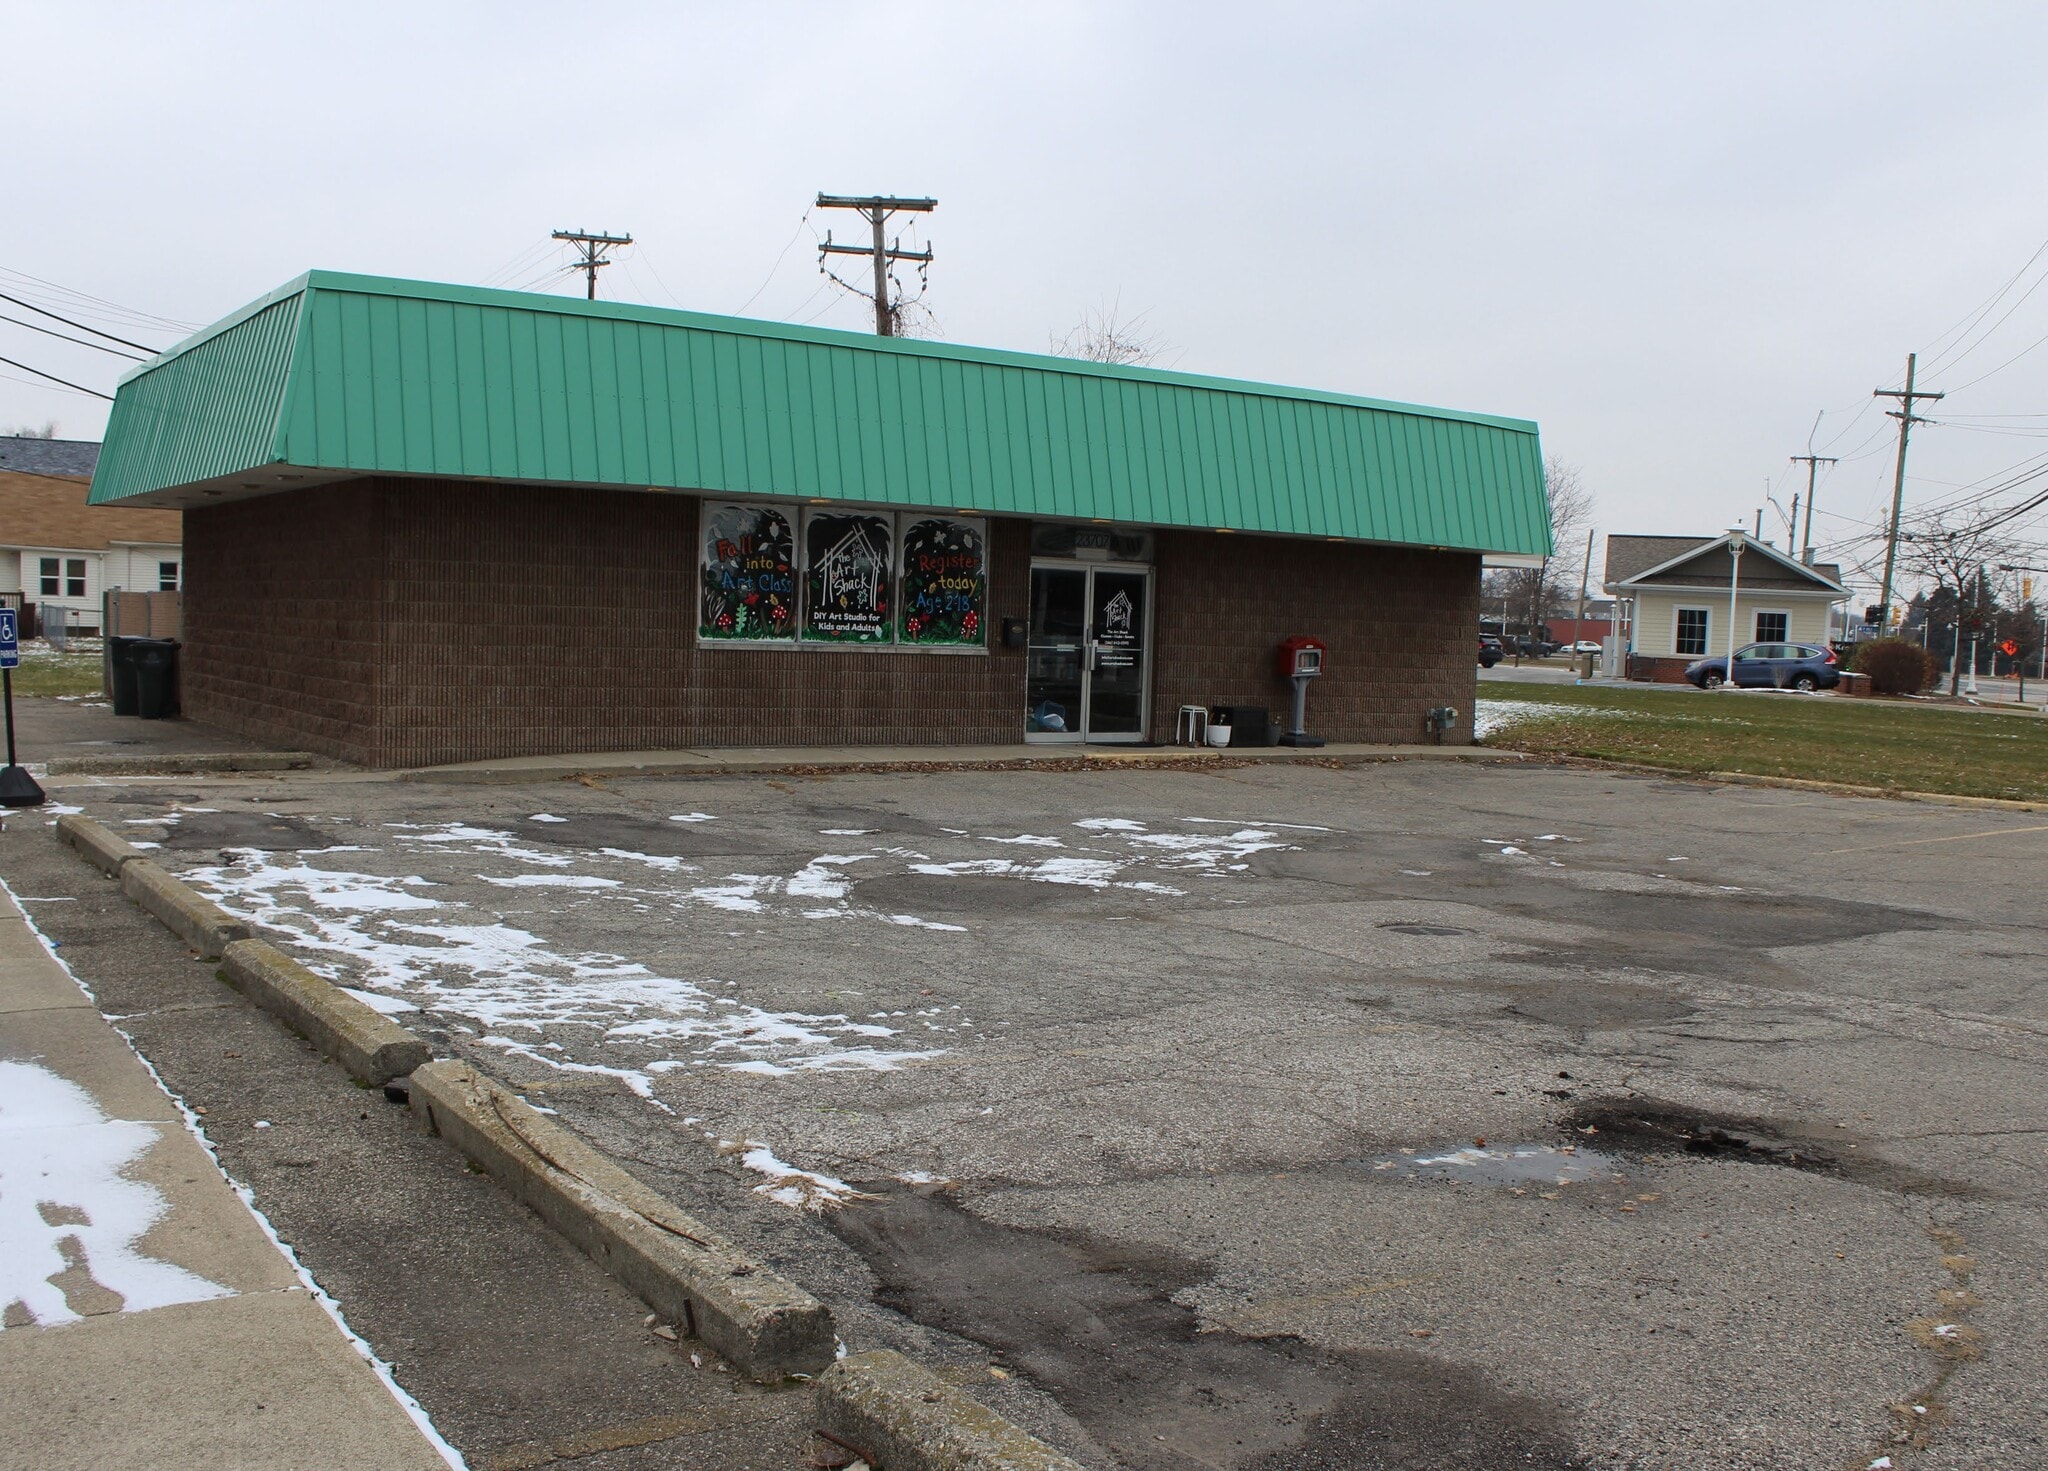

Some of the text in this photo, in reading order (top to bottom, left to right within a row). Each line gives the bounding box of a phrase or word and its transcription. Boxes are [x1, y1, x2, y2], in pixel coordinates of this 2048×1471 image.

[717, 536, 753, 562] Fall
[746, 556, 774, 570] into
[836, 560, 860, 578] Art
[919, 553, 980, 575] Register
[722, 571, 753, 589] Art
[759, 574, 792, 593] Class
[834, 572, 871, 596] Shack
[938, 575, 978, 598] today
[916, 592, 942, 614] Age
[814, 612, 827, 620] DIY
[829, 612, 842, 620] Art
[818, 622, 834, 630] Kids
